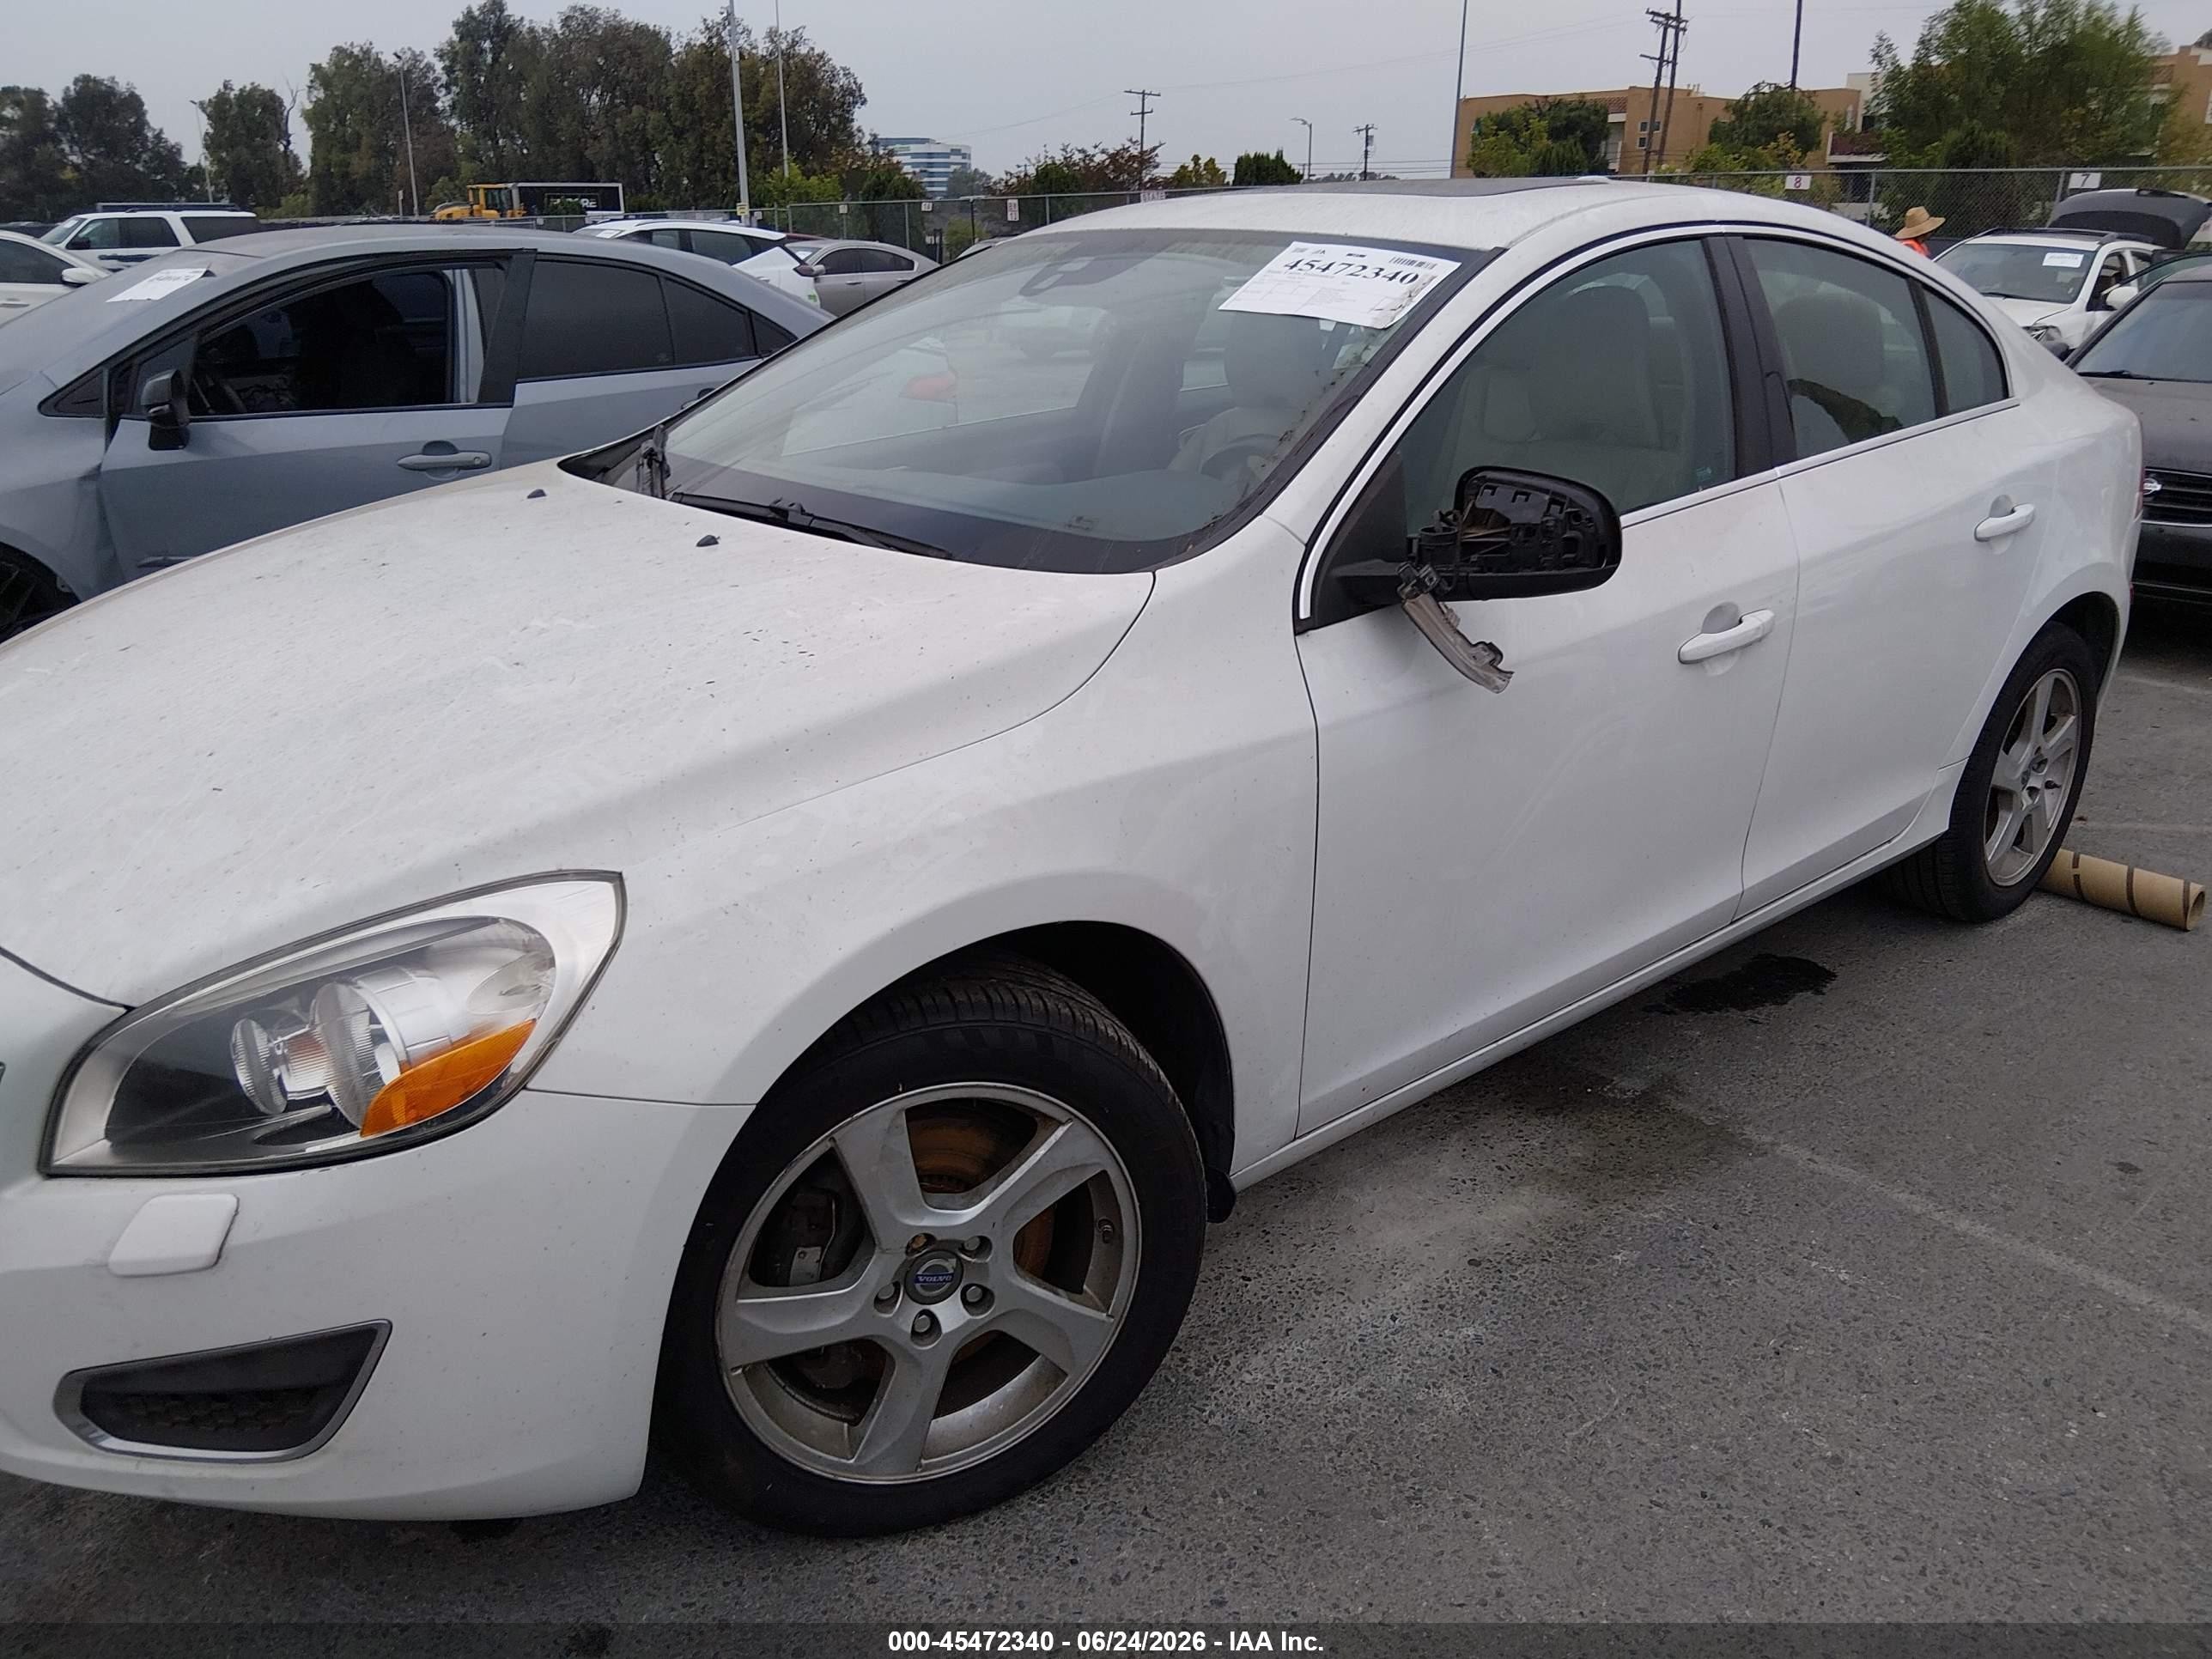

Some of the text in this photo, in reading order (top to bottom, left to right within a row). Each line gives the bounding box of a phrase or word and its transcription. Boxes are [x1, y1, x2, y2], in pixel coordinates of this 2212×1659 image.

[1794, 176, 1802, 189] 8
[2081, 173, 2090, 187] 7
[1284, 258, 1419, 285] 45472340
